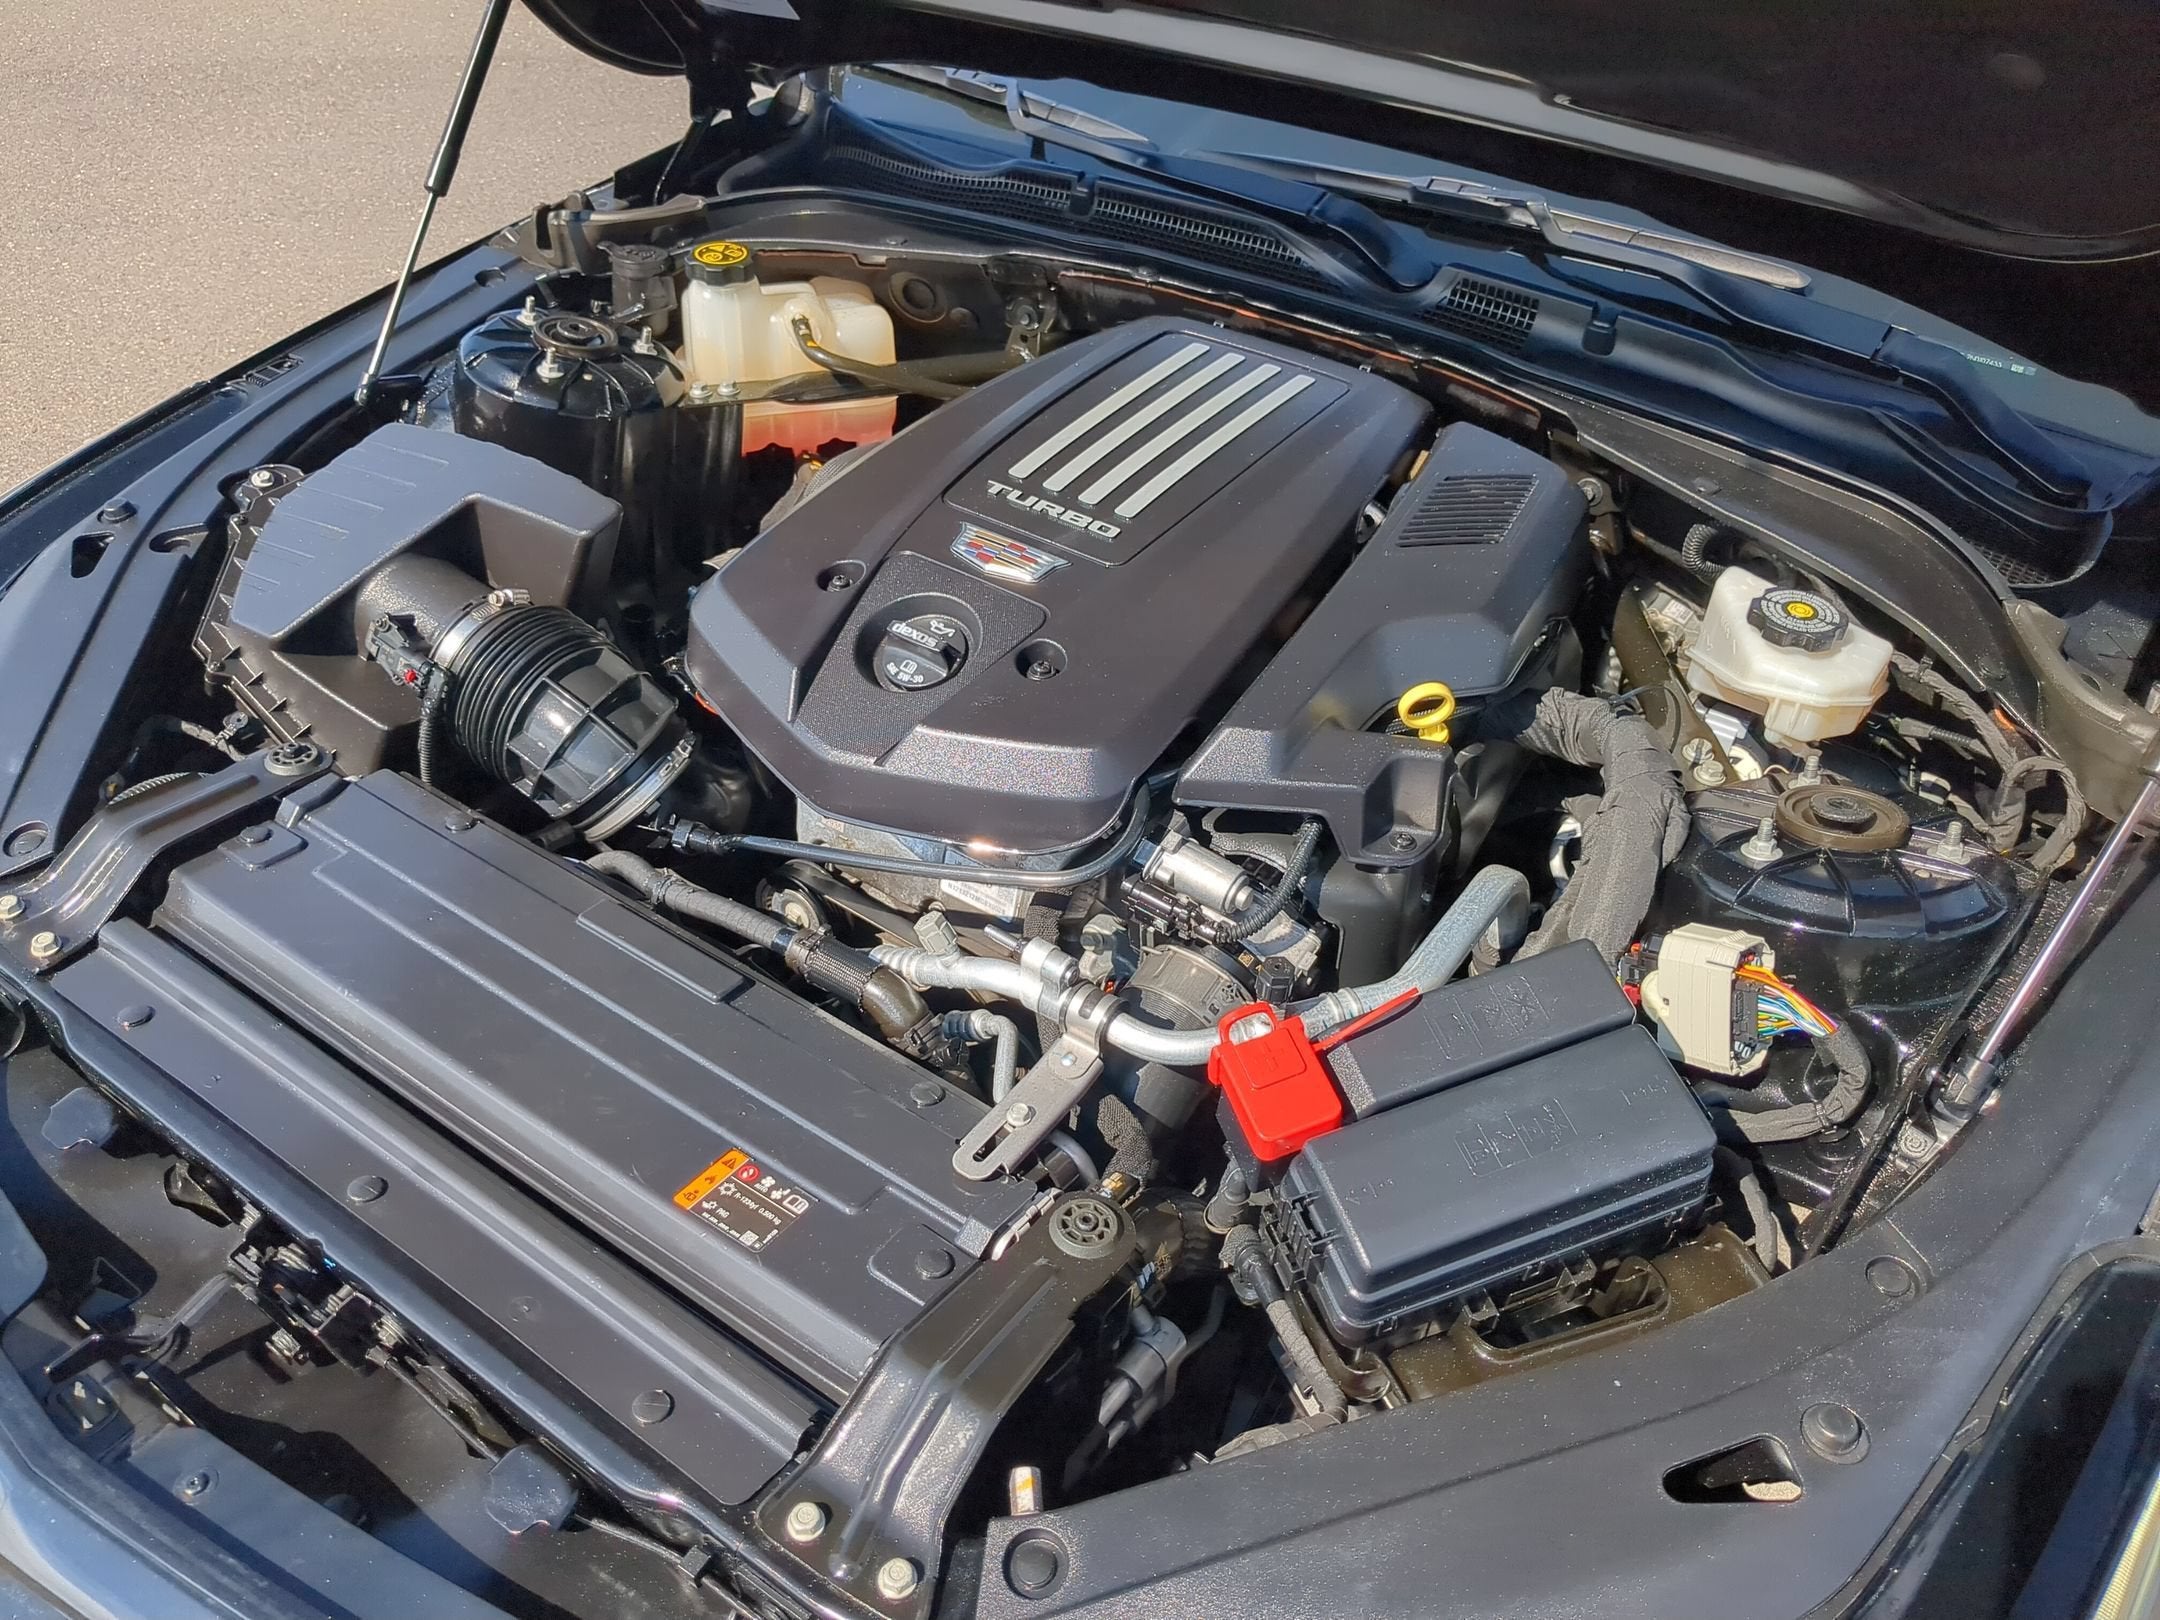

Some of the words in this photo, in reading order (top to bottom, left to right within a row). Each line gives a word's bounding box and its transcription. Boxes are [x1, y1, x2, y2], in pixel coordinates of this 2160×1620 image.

[987, 480, 1122, 539] TURBO
[892, 622, 939, 648] dexos
[886, 662, 900, 675] SAE
[897, 672, 924, 683] 5W-30
